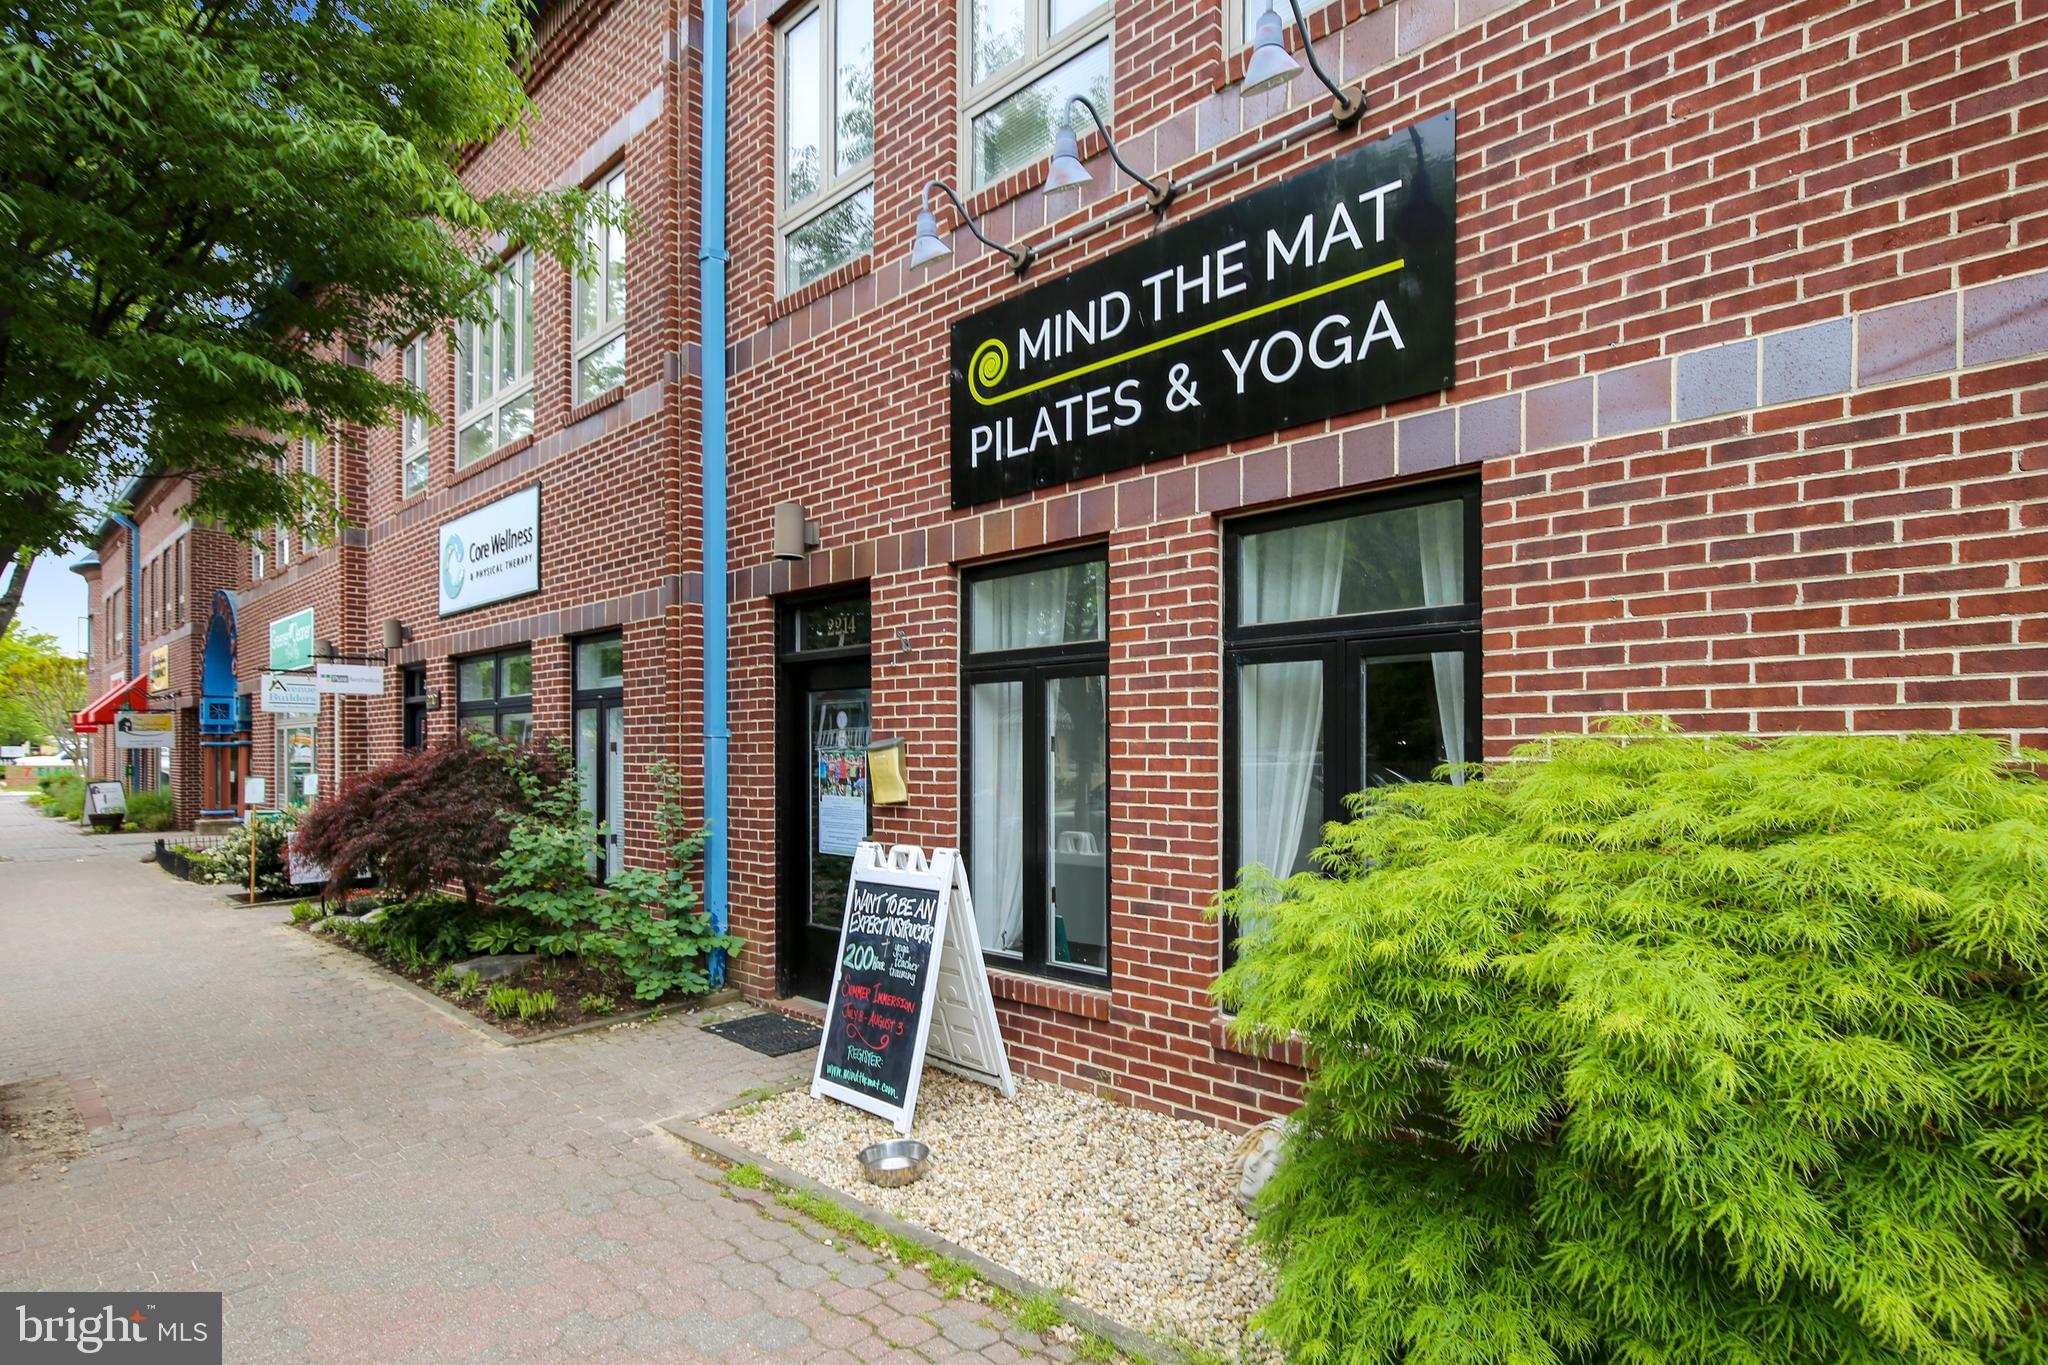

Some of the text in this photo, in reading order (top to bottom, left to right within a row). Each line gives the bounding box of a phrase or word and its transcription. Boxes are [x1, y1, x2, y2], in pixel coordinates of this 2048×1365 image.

[1018, 179, 1402, 370] MIND THE MAT
[970, 299, 1405, 469] PILATES & YOGA
[469, 526, 533, 563] Core Wellness
[476, 563, 503, 580] PHYSICAL
[505, 553, 533, 570] THERAPY
[827, 615, 856, 636] 2214
[269, 692, 316, 702] Builders
[854, 888, 936, 921] WANT TO BE AN
[849, 911, 935, 944] EXPERT INSTRUCTOR
[843, 943, 875, 971] 200
[892, 943, 910, 958] yoga
[894, 956, 920, 972] teacher
[889, 963, 916, 986] training
[868, 1010, 896, 1033] AUGUST
[896, 1021, 904, 1035] 3
